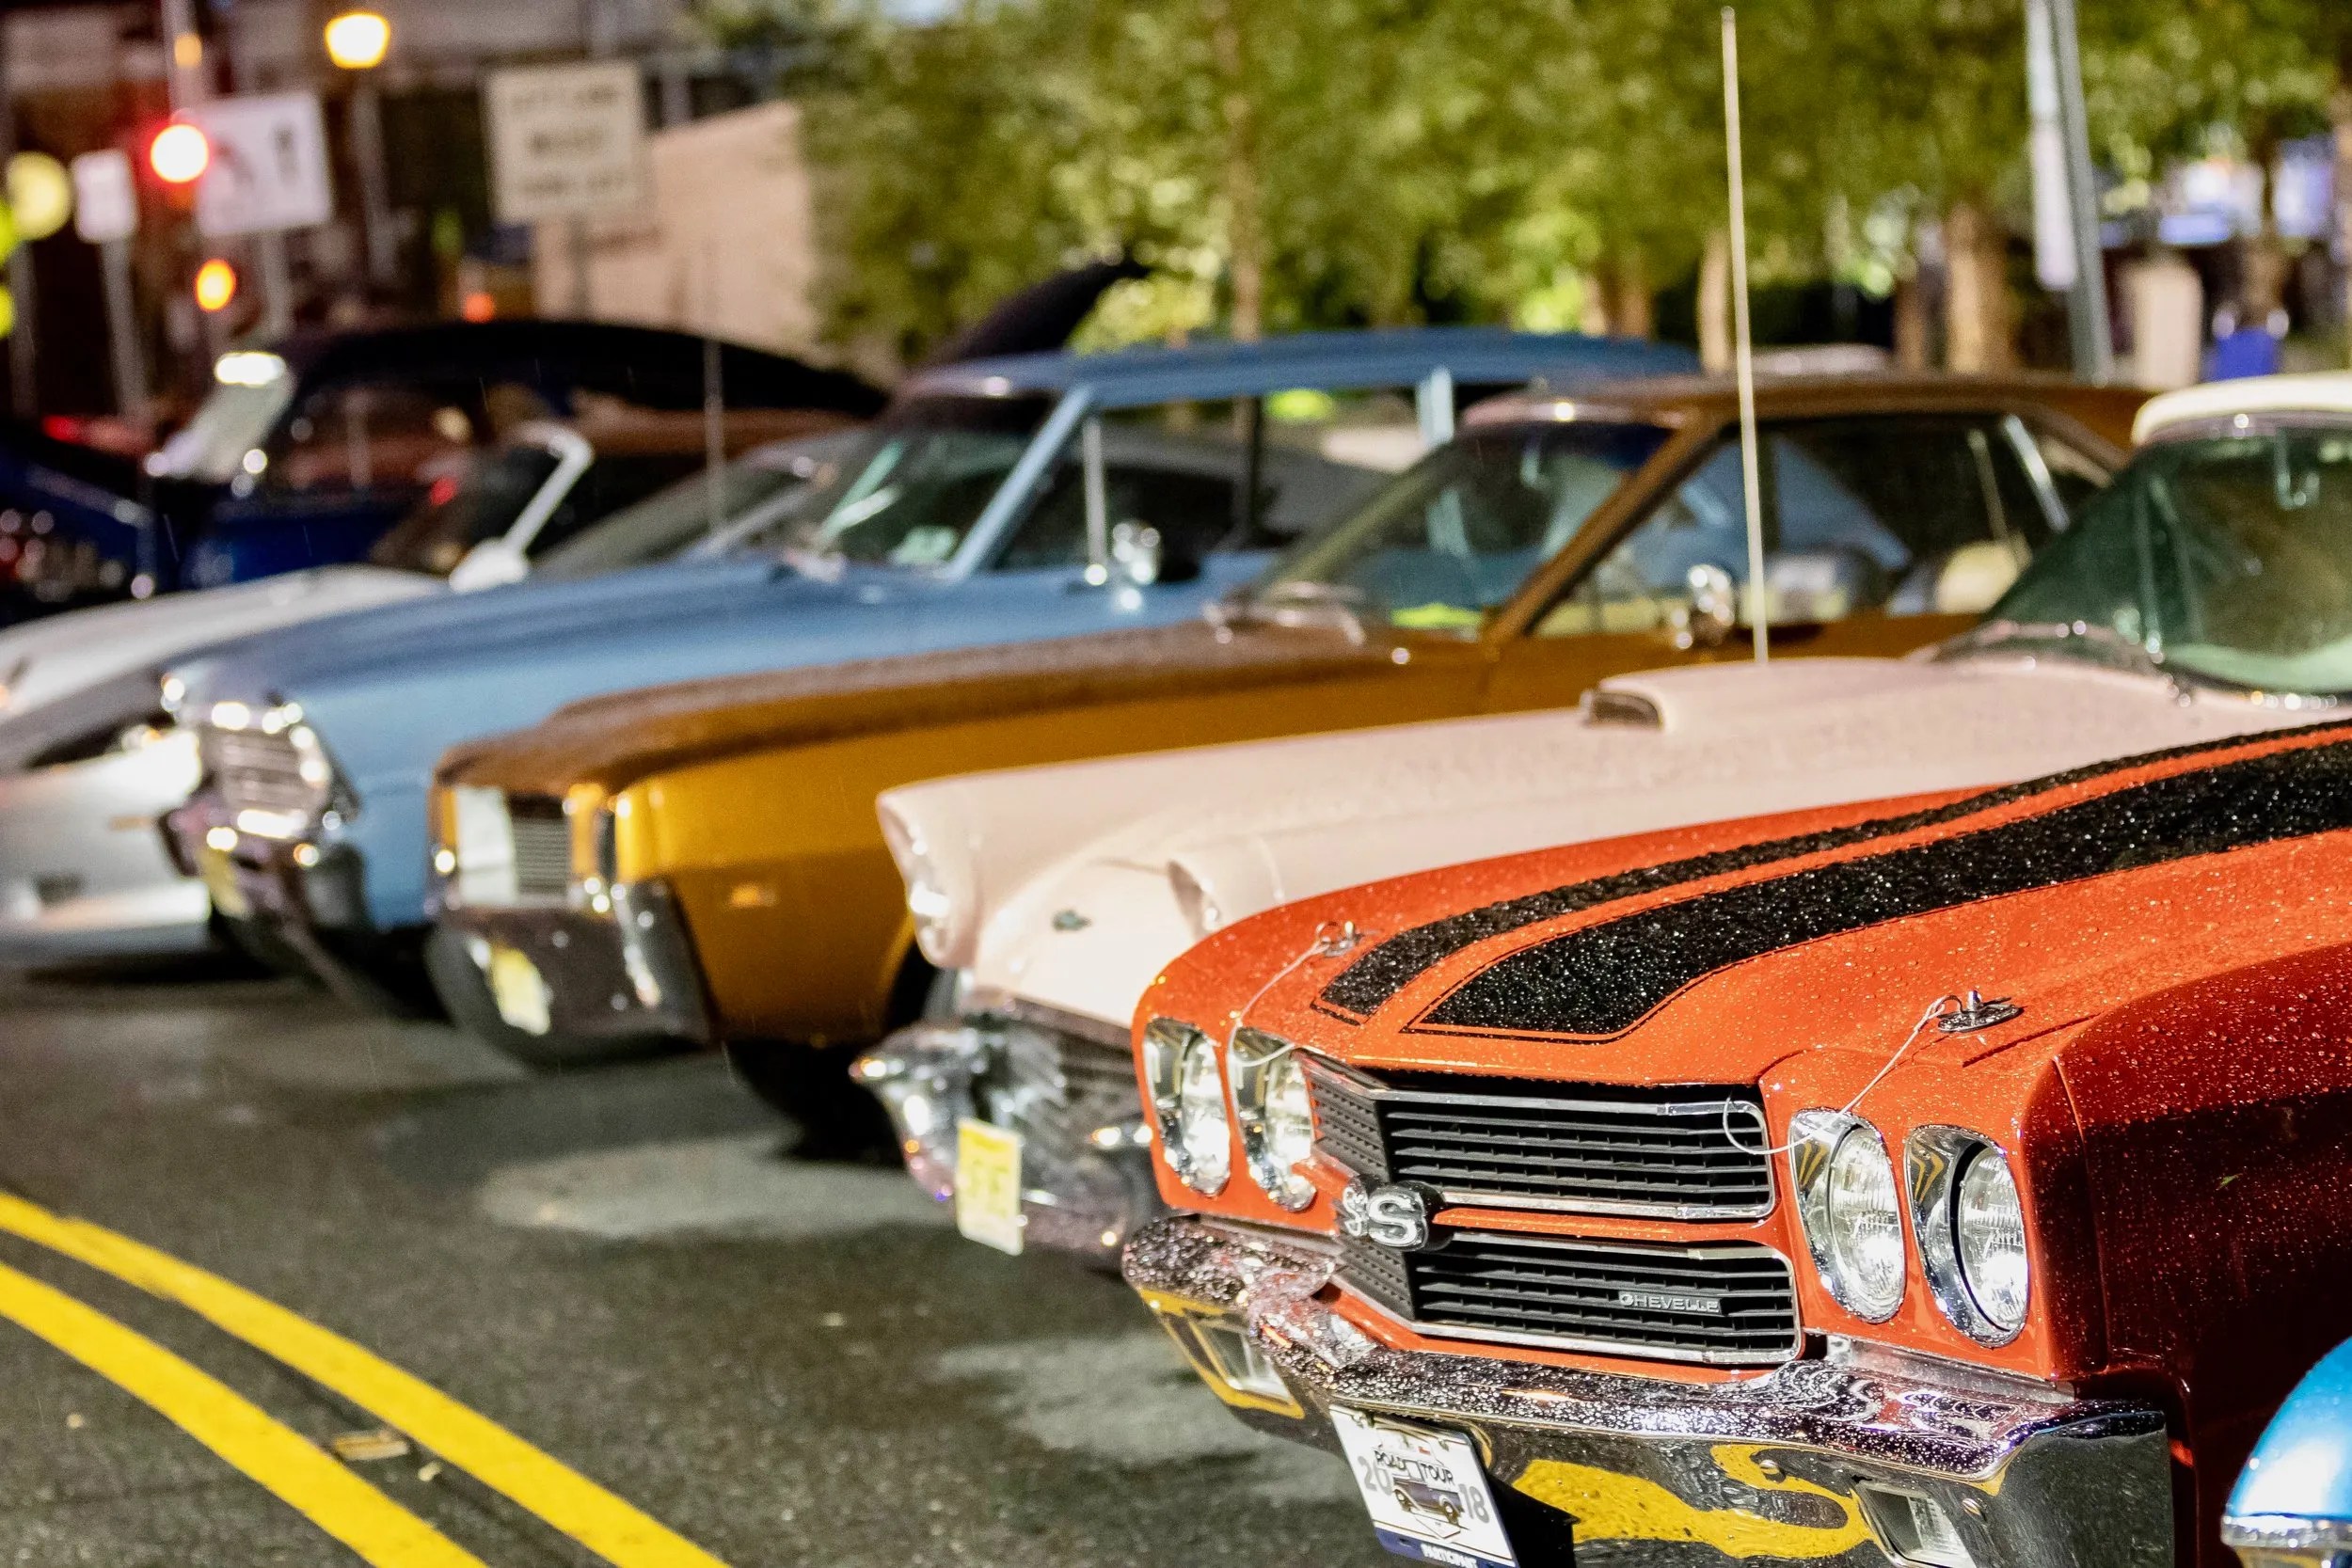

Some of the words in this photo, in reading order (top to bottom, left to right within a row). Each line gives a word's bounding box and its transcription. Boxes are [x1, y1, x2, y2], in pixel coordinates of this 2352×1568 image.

[1619, 1293, 1720, 1313] CHEVELLE
[1421, 1463, 1454, 1485] TOUR
[1458, 1483, 1490, 1523] 18
